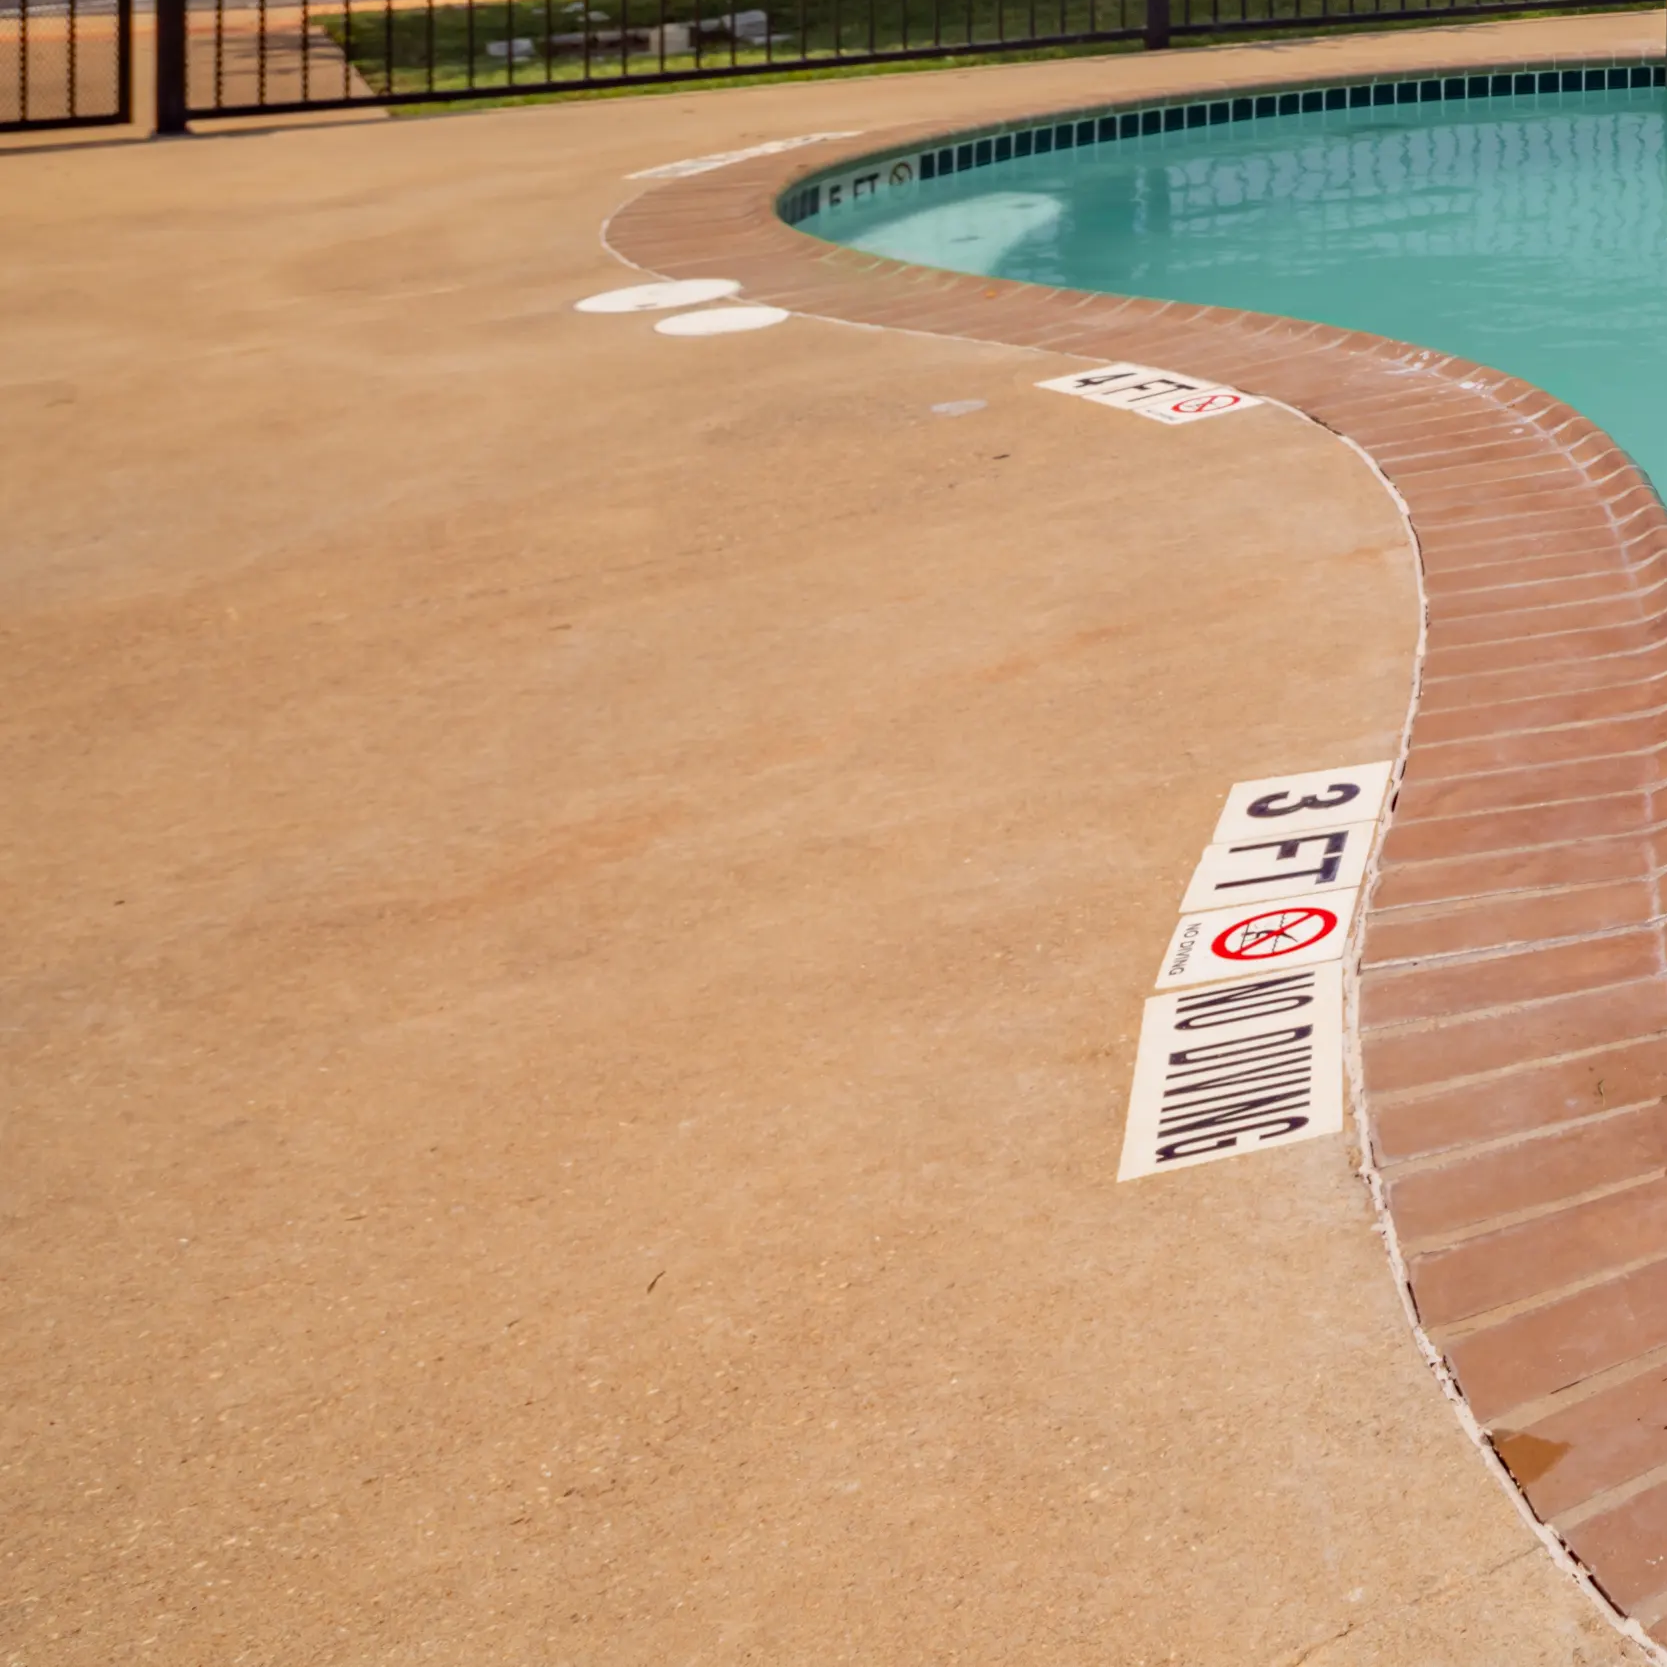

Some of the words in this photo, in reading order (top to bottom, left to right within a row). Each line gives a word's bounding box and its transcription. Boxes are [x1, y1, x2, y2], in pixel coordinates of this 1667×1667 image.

[854, 173, 880, 199] FT
[1074, 373, 1137, 389] 4
[1102, 379, 1199, 403] FT
[1246, 782, 1361, 819] 3
[1214, 829, 1350, 891] FT
[1184, 923, 1202, 938] NO
[1169, 941, 1195, 976] DIVING
[1174, 970, 1315, 1030] NO
[1154, 1024, 1314, 1164] DIVING
